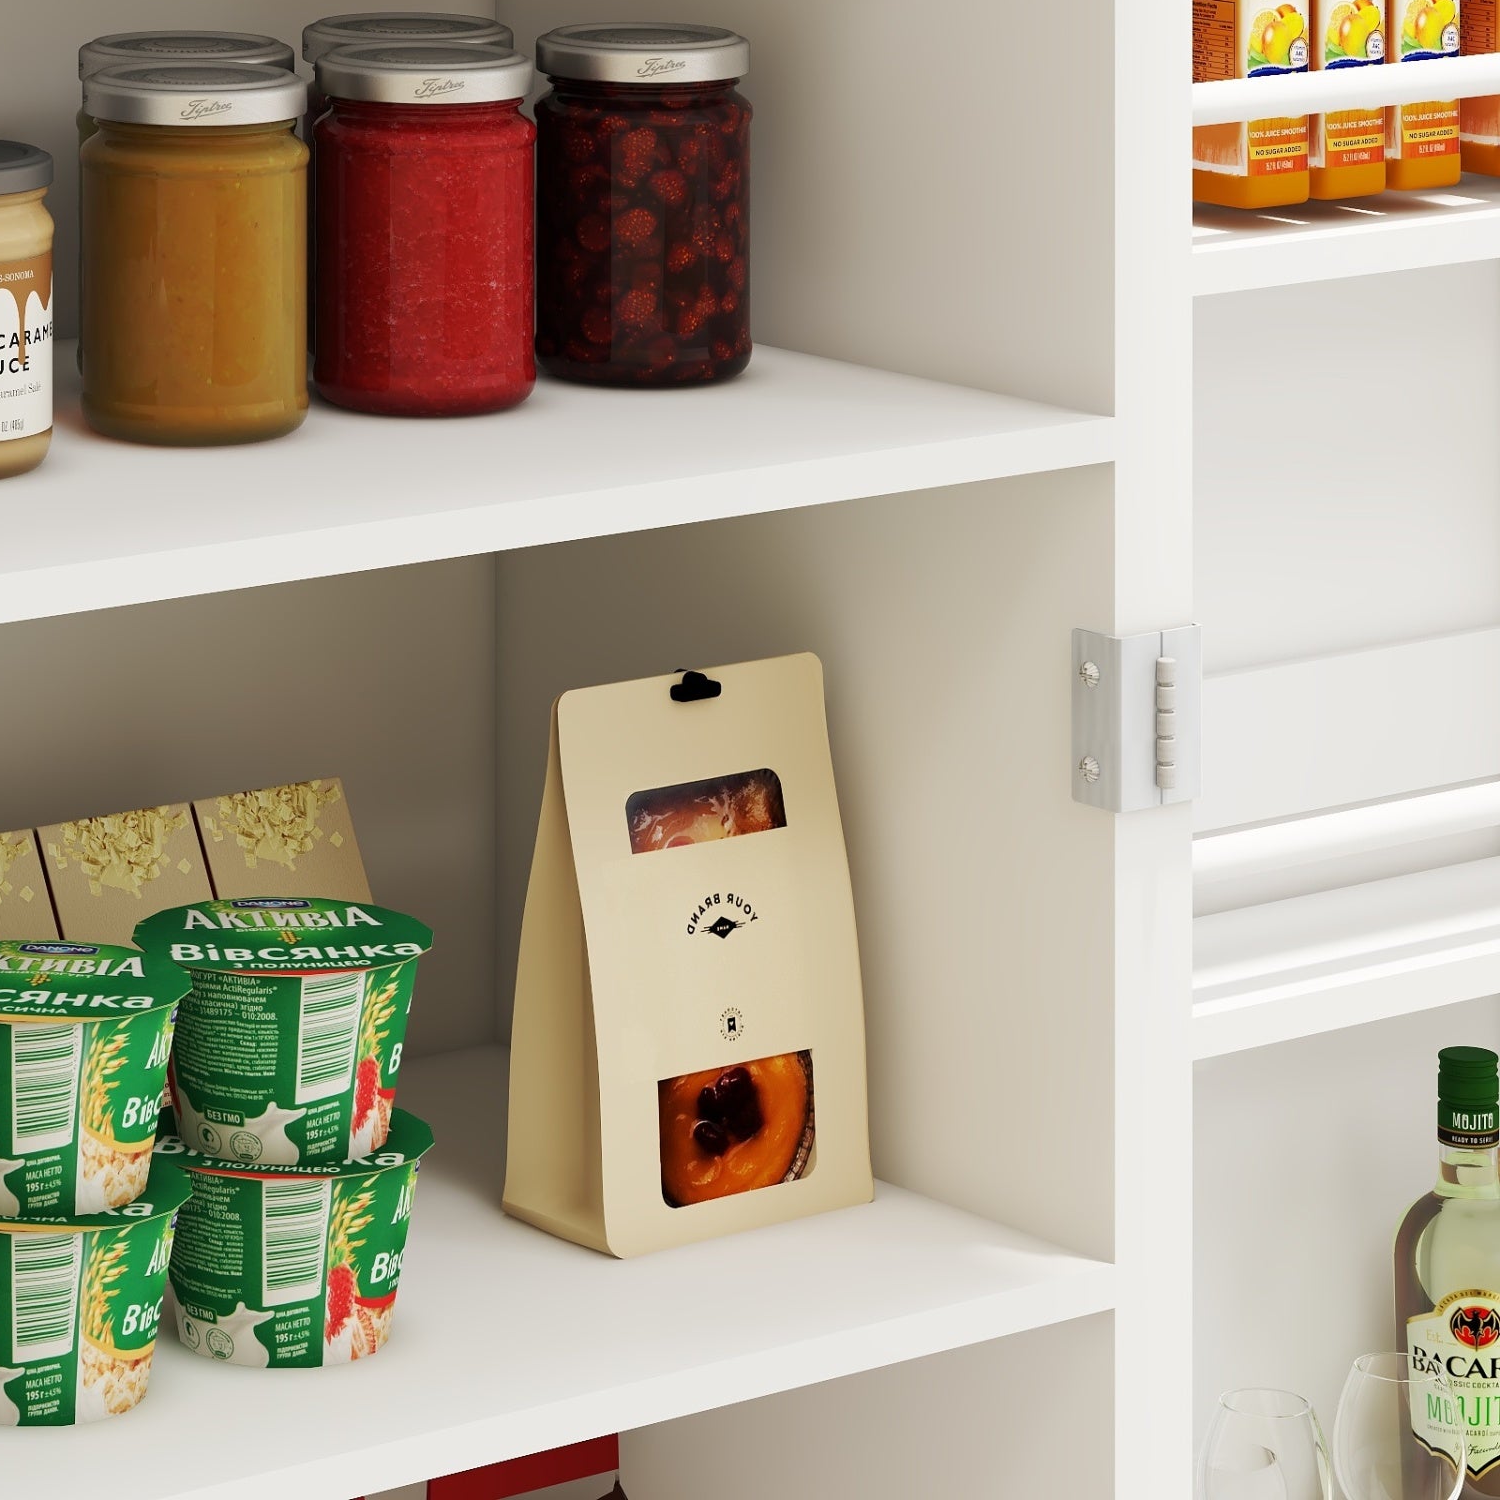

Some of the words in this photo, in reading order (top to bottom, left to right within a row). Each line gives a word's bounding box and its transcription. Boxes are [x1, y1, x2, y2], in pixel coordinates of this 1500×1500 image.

[637, 57, 686, 77] Tiptree
[414, 77, 465, 99] Tiptree
[180, 99, 233, 120] Tiptree
[1333, 140, 1342, 148] NO
[1343, 138, 1360, 147] SUGAR
[1361, 137, 1378, 145] ADDED
[1265, 147, 1283, 156] SUGAR
[1284, 145, 1302, 154] ADDED
[183, 907, 384, 931] АКТИВІА
[170, 942, 424, 962] Вівсянка
[250, 959, 371, 970] ПОЛУНИЦЕЮ
[207, 1110, 222, 1121] БЕЗ
[223, 1113, 241, 1125] ГМО
[1452, 1112, 1494, 1130] MOJITO
[306, 1129, 319, 1140] 195
[219, 1161, 341, 1174] ПОЛУНИЦЕЮ
[26, 1390, 39, 1401] 195
